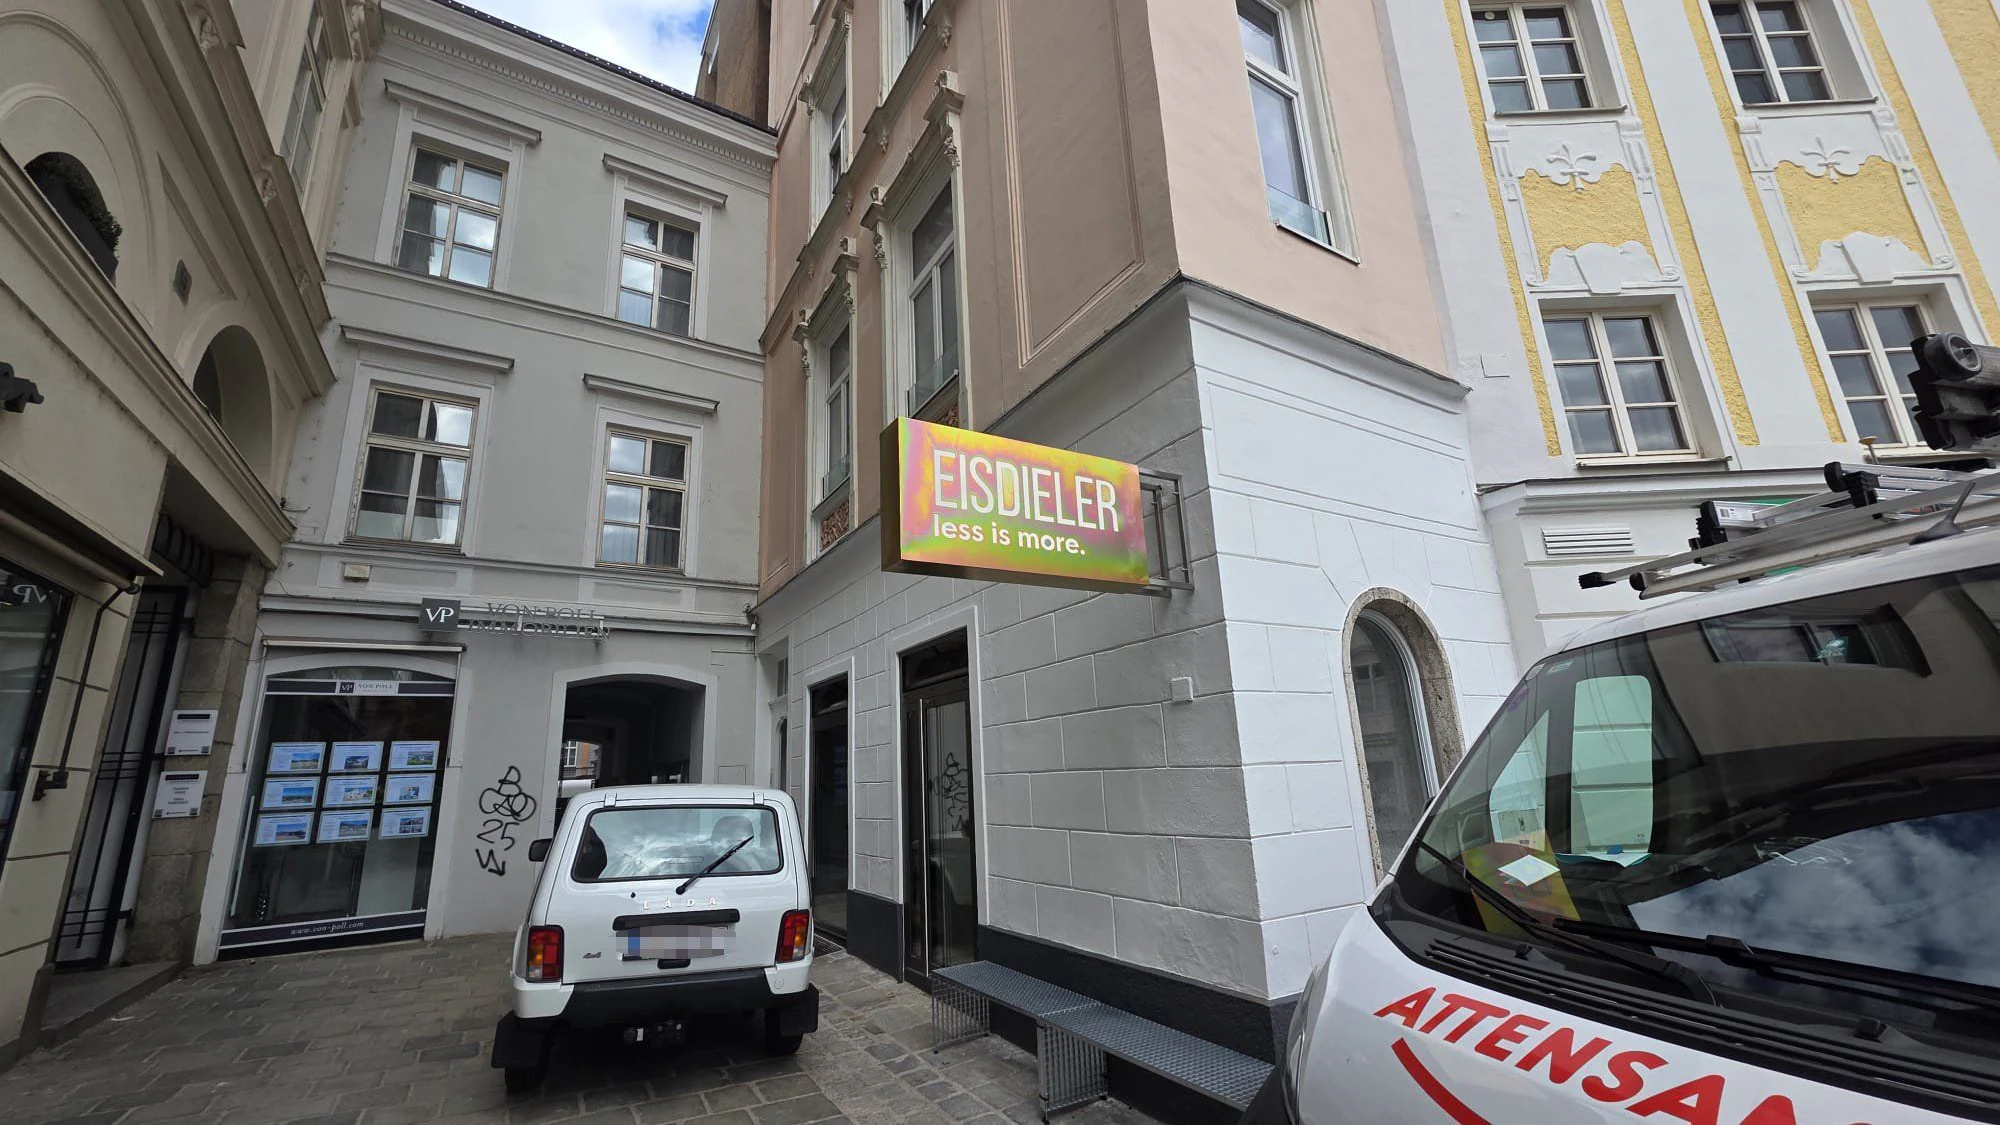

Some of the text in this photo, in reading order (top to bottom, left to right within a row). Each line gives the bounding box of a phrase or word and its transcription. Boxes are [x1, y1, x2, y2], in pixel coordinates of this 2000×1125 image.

[933, 448, 1120, 532] EISDIELER
[933, 513, 1086, 556] less is more.
[425, 607, 455, 624] VP
[487, 602, 598, 620] VON POLL
[642, 896, 717, 911] LADA
